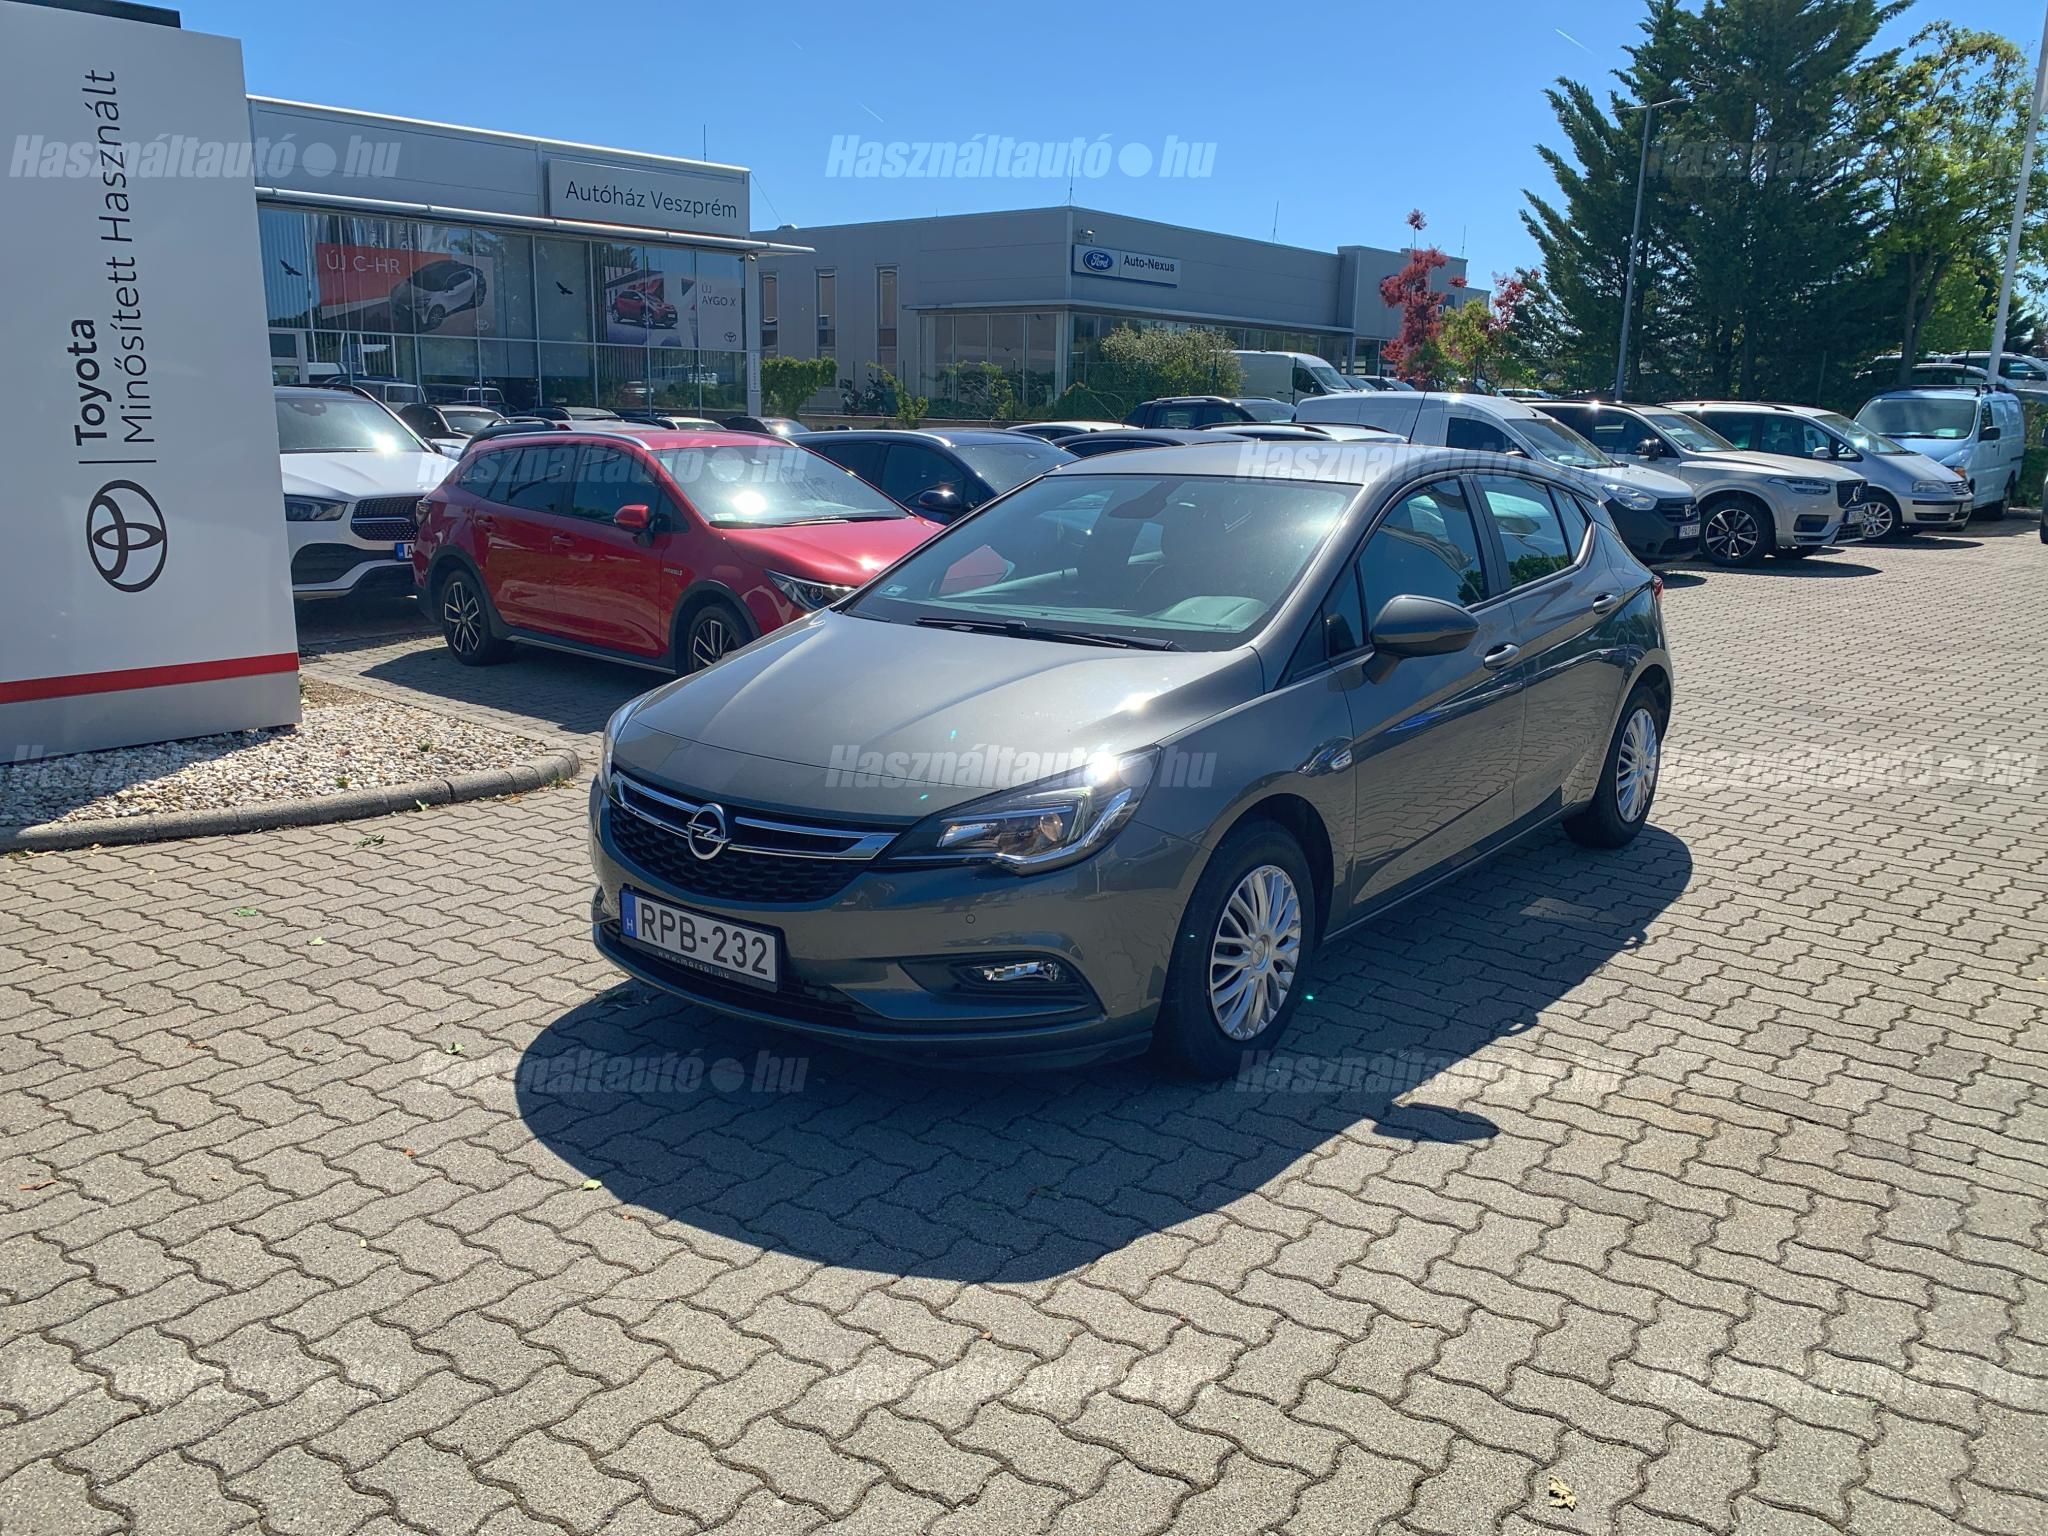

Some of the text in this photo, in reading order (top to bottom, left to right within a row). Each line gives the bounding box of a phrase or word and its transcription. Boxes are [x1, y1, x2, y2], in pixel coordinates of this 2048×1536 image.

[565, 180, 737, 219] Autóház Veszprém
[81, 68, 155, 443] Minősített Használt
[326, 249, 401, 274] ÚJ C-HR
[1090, 253, 1175, 272] Ford Auto-Nexus
[702, 295, 737, 307] AYGO X
[67, 318, 112, 447] Toyota
[626, 917, 634, 932] H
[641, 902, 768, 976] RPB-232
